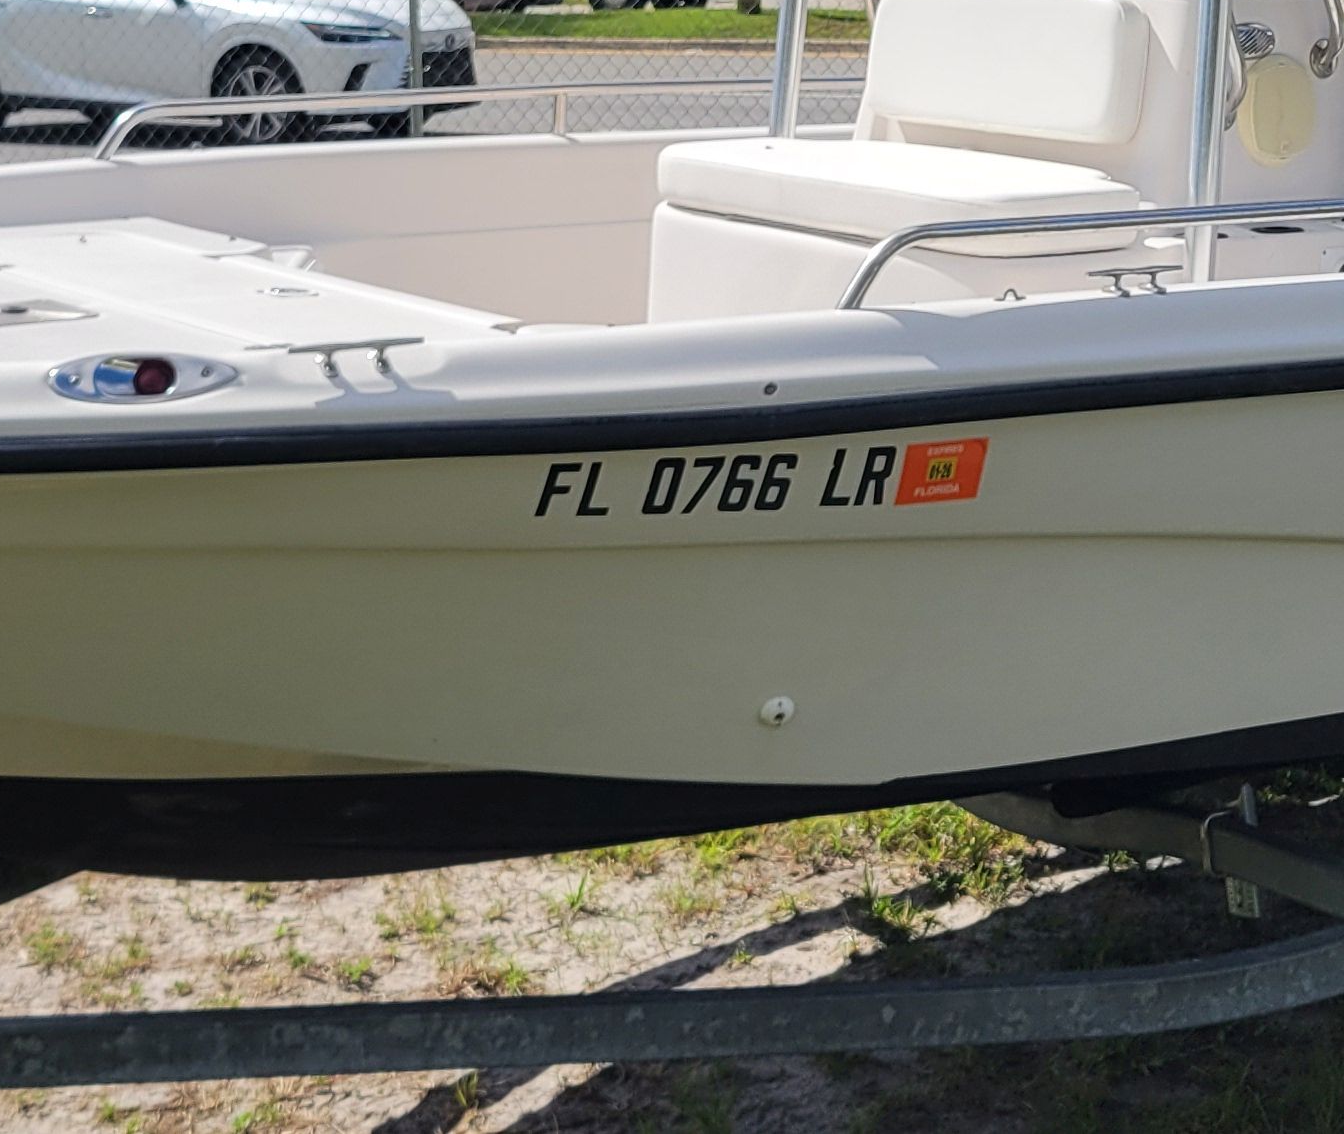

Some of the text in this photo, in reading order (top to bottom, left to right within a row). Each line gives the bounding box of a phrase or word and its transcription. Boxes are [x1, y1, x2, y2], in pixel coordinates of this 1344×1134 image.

[534, 446, 898, 517] FL 0766 LR
[913, 483, 960, 497] FLORIDA
